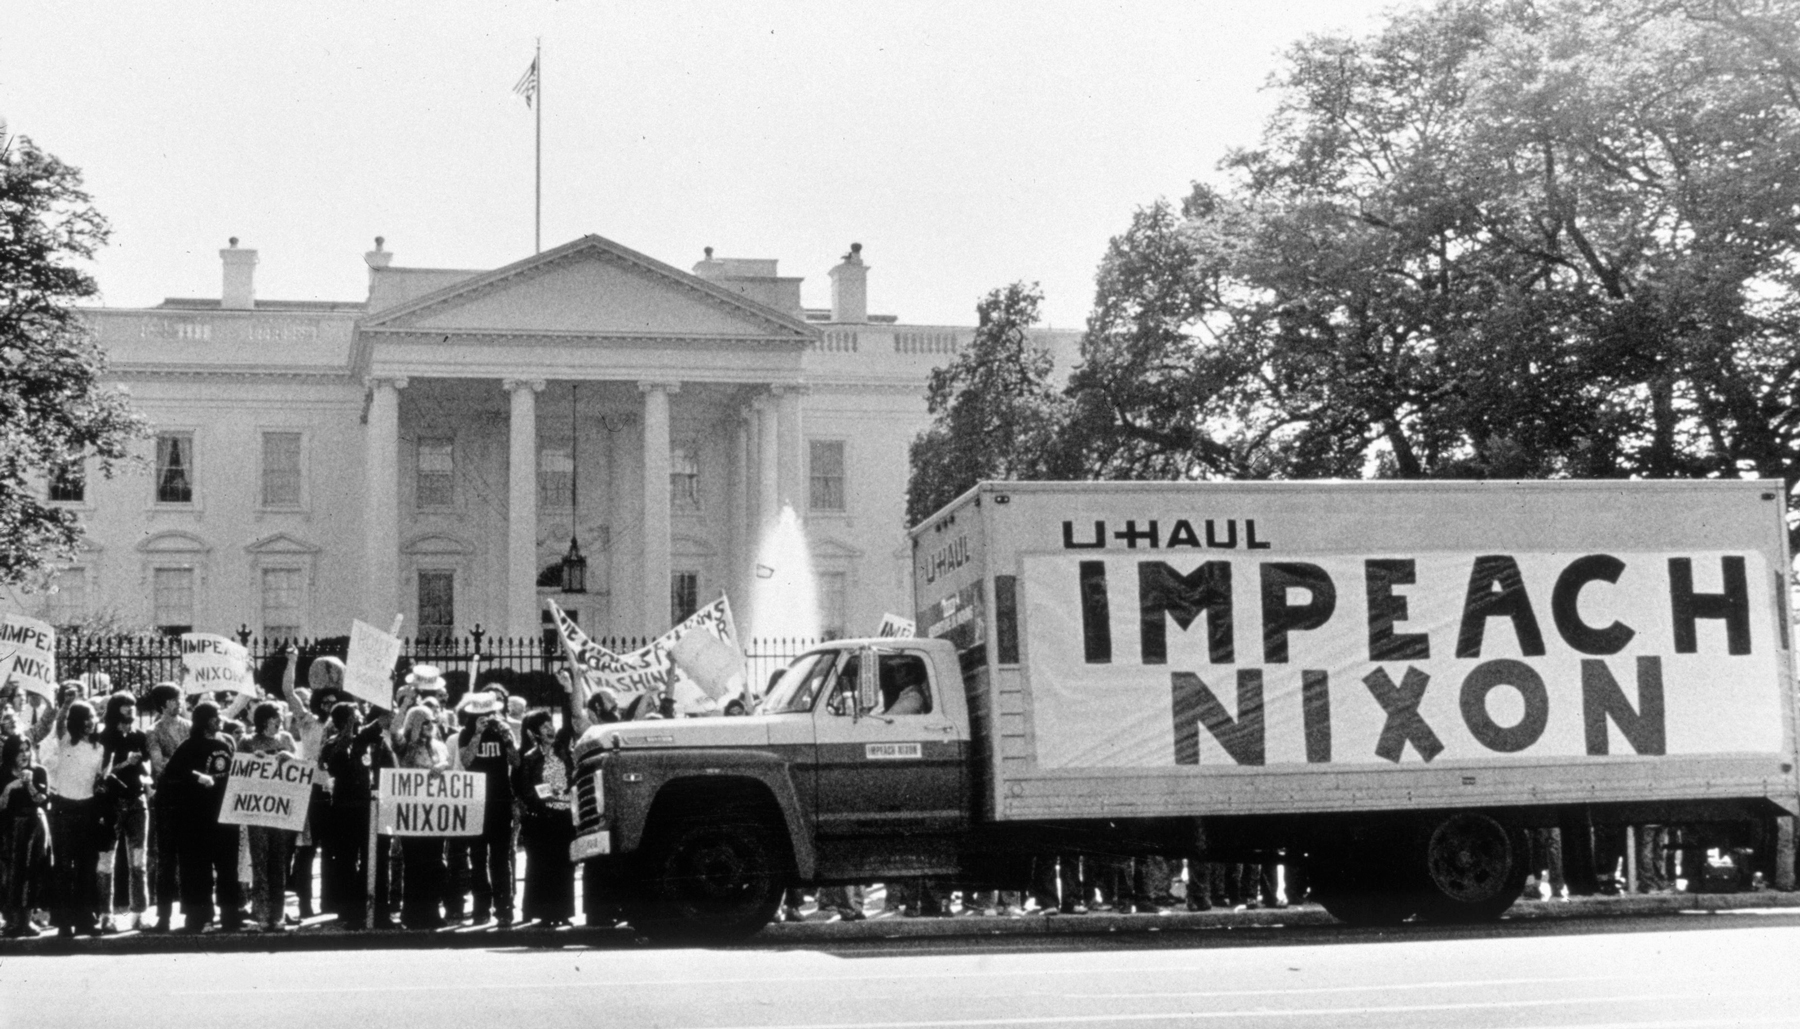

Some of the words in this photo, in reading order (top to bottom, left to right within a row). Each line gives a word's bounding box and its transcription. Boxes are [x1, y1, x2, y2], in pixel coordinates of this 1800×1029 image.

[1079, 554, 1752, 664] IMPEACH
[2, 624, 51, 652] IMPE
[184, 639, 227, 655] IMPE
[1171, 655, 1667, 766] NIXON
[231, 759, 314, 785] IMPEACH
[392, 773, 474, 799] IMPEACH
[234, 794, 290, 815] NIXON
[397, 804, 467, 832] NIXON
